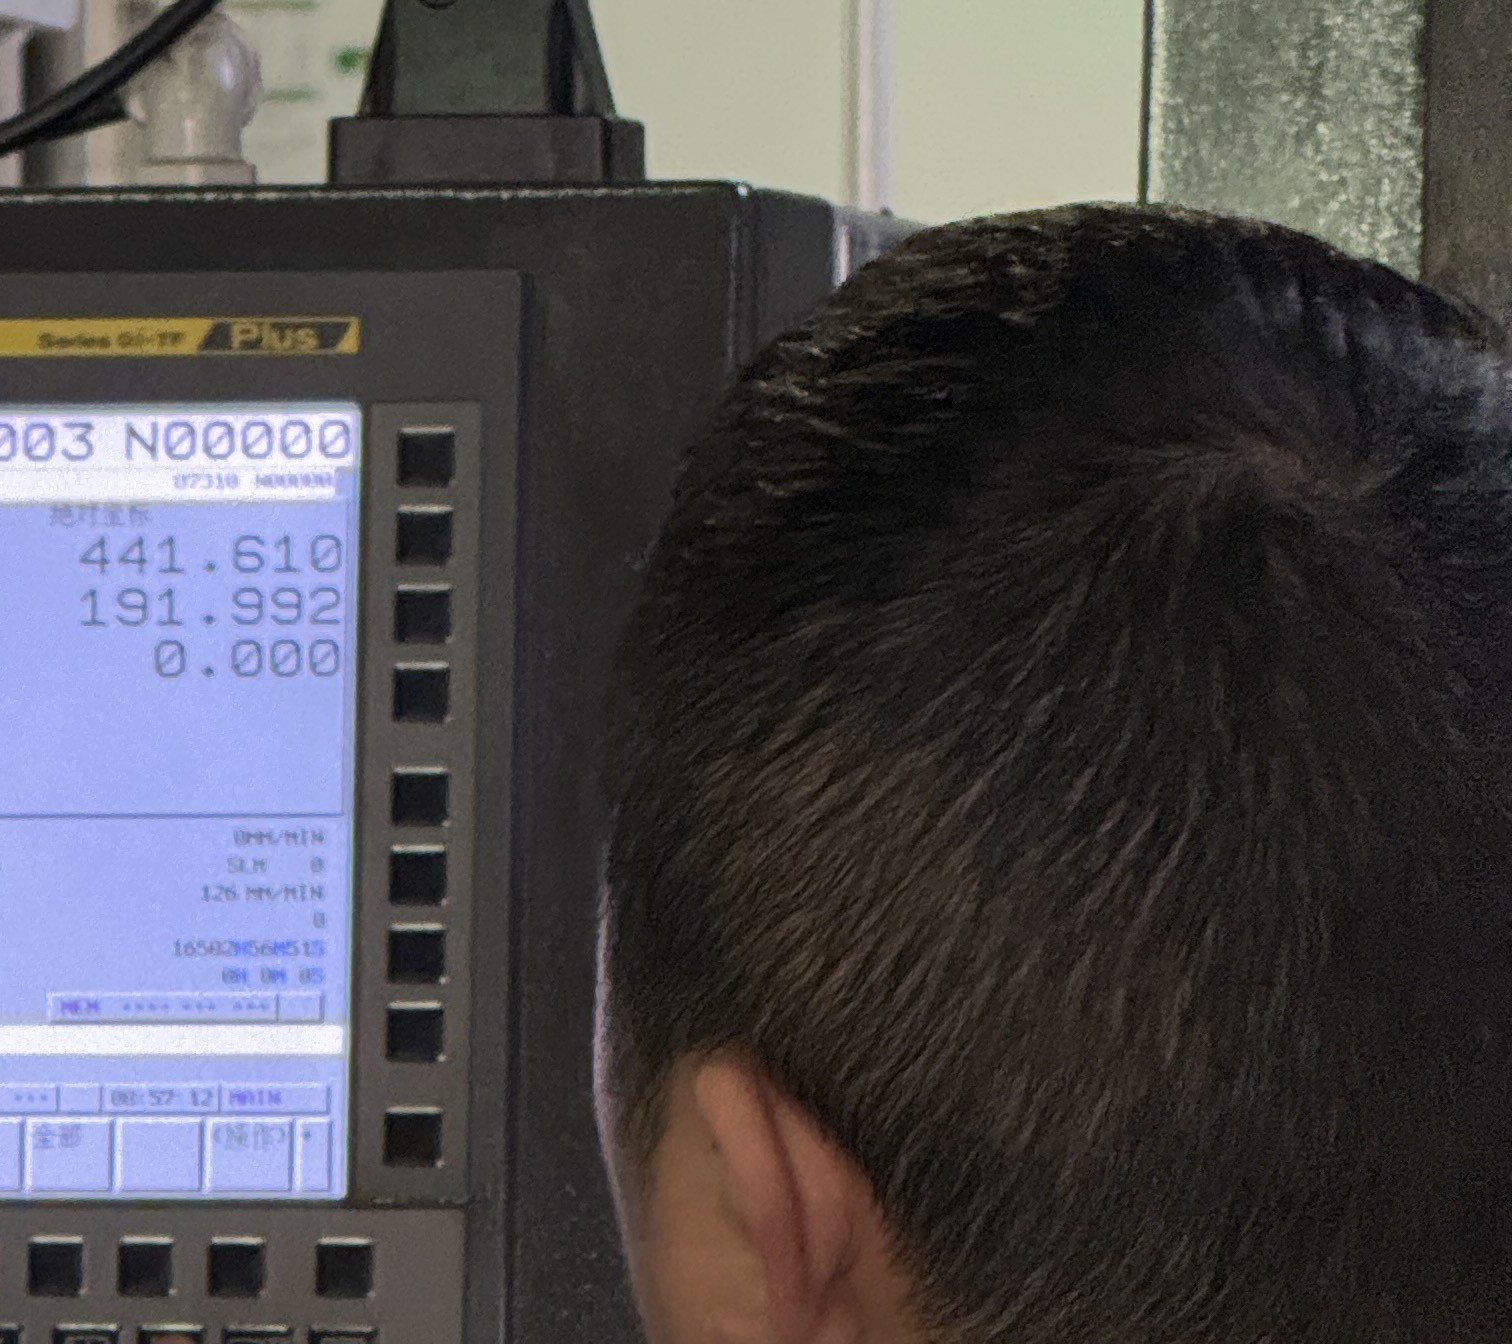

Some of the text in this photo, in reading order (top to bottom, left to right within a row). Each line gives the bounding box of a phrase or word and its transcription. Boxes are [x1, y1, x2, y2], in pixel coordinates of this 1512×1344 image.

[37, 330, 111, 349] Series
[230, 322, 320, 350] Plus
[124, 419, 352, 461] N00000
[79, 533, 344, 575] 441.610
[79, 585, 343, 628] 191.992
[153, 638, 341, 679] 0.000
